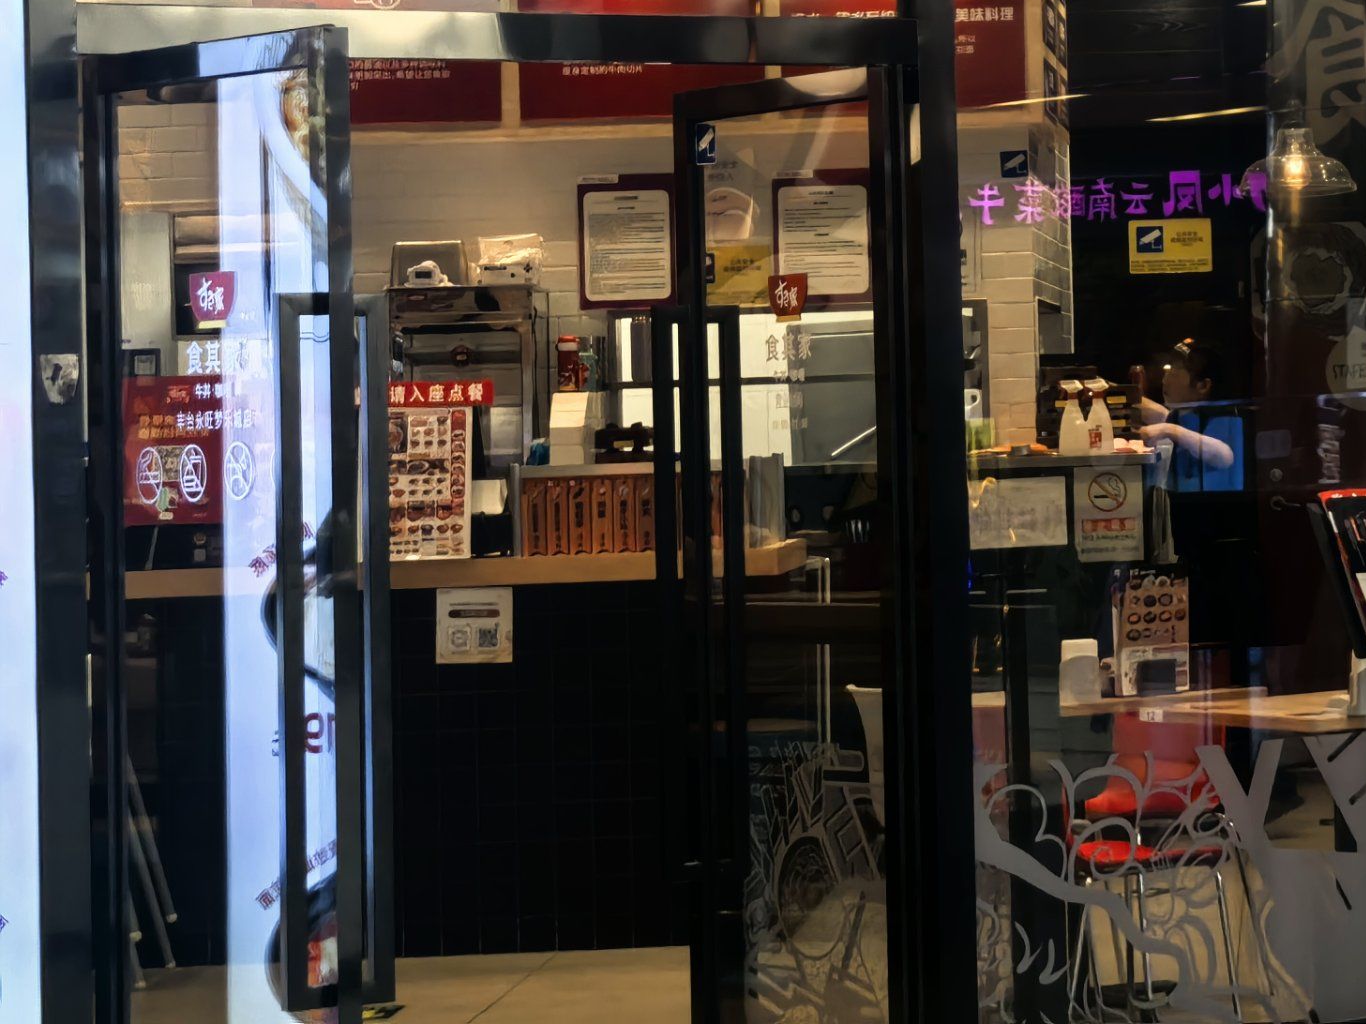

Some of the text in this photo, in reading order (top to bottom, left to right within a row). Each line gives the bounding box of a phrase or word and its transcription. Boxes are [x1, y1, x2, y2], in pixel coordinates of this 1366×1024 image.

[955, 6, 1014, 22] 美味料理
[389, 384, 484, 405] 请入座点餐
